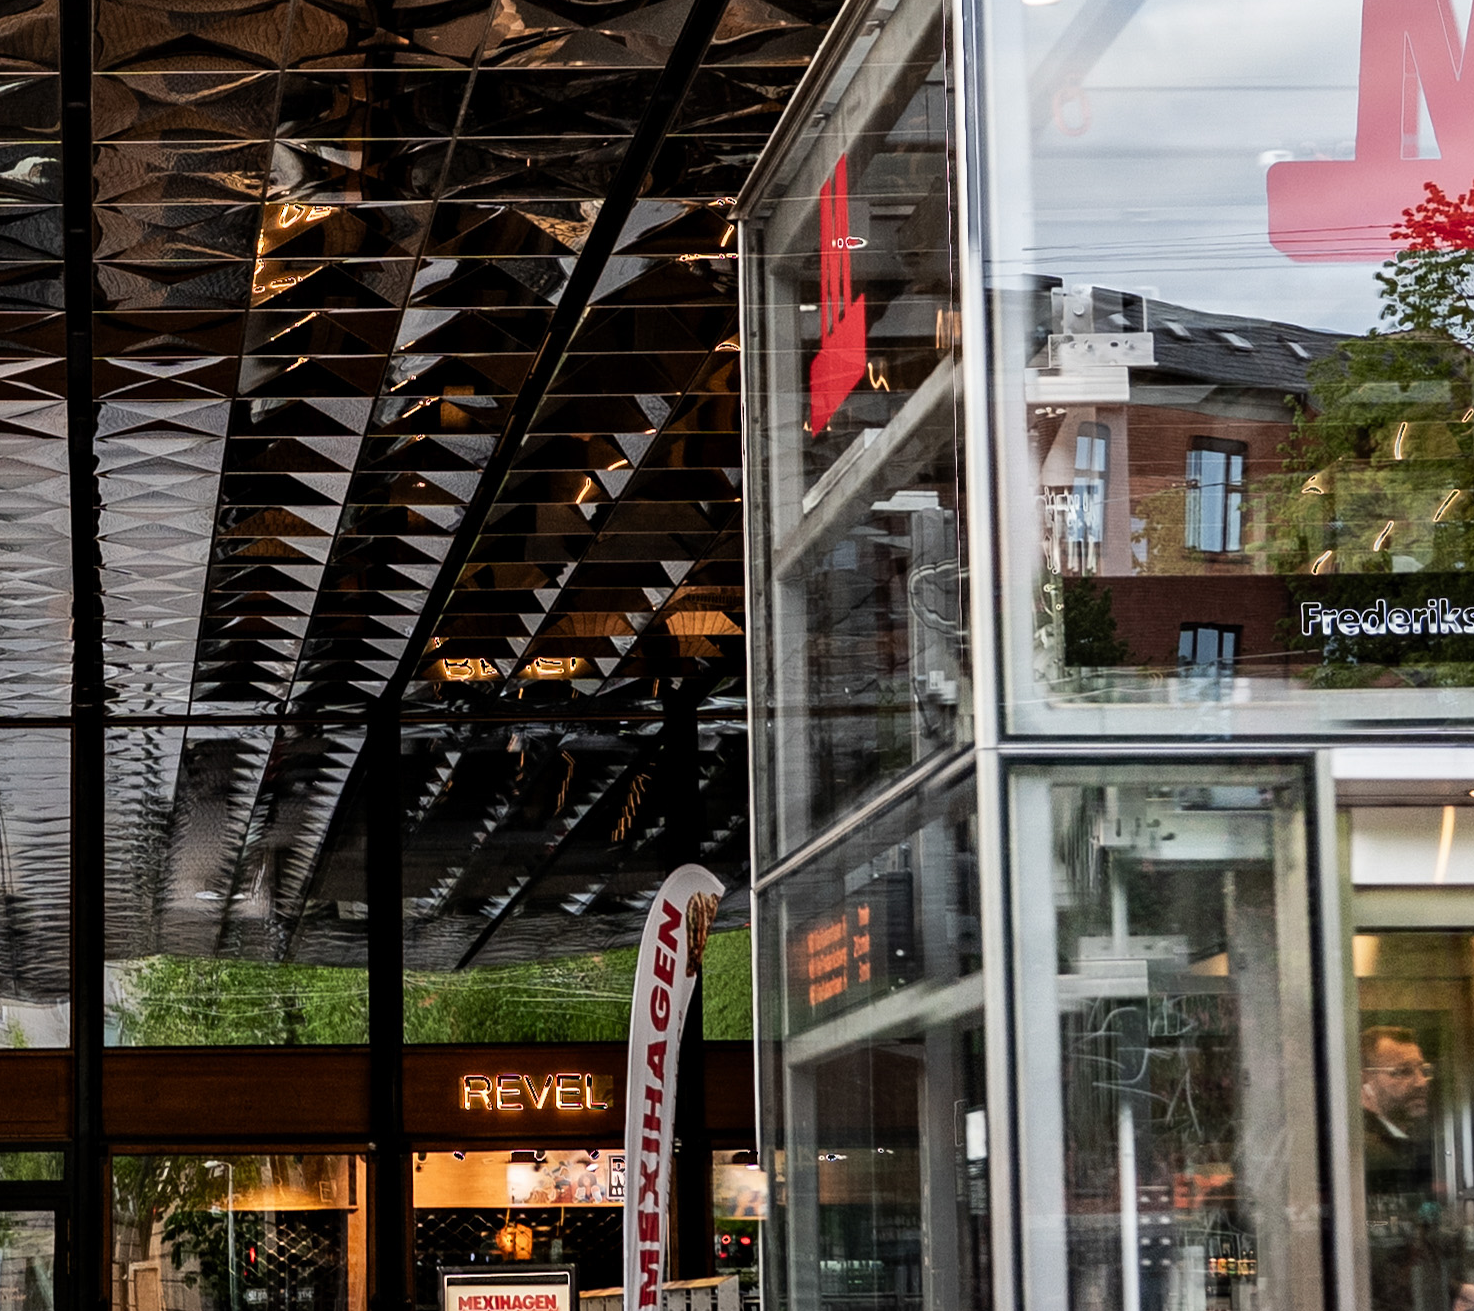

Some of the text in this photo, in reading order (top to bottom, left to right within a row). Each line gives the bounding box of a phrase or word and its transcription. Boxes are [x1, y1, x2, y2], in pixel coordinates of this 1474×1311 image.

[463, 1072, 608, 1111] REVEL
[638, 898, 683, 1310] MEXIHAGEN
[458, 1294, 557, 1311] MEXIHAGEN
